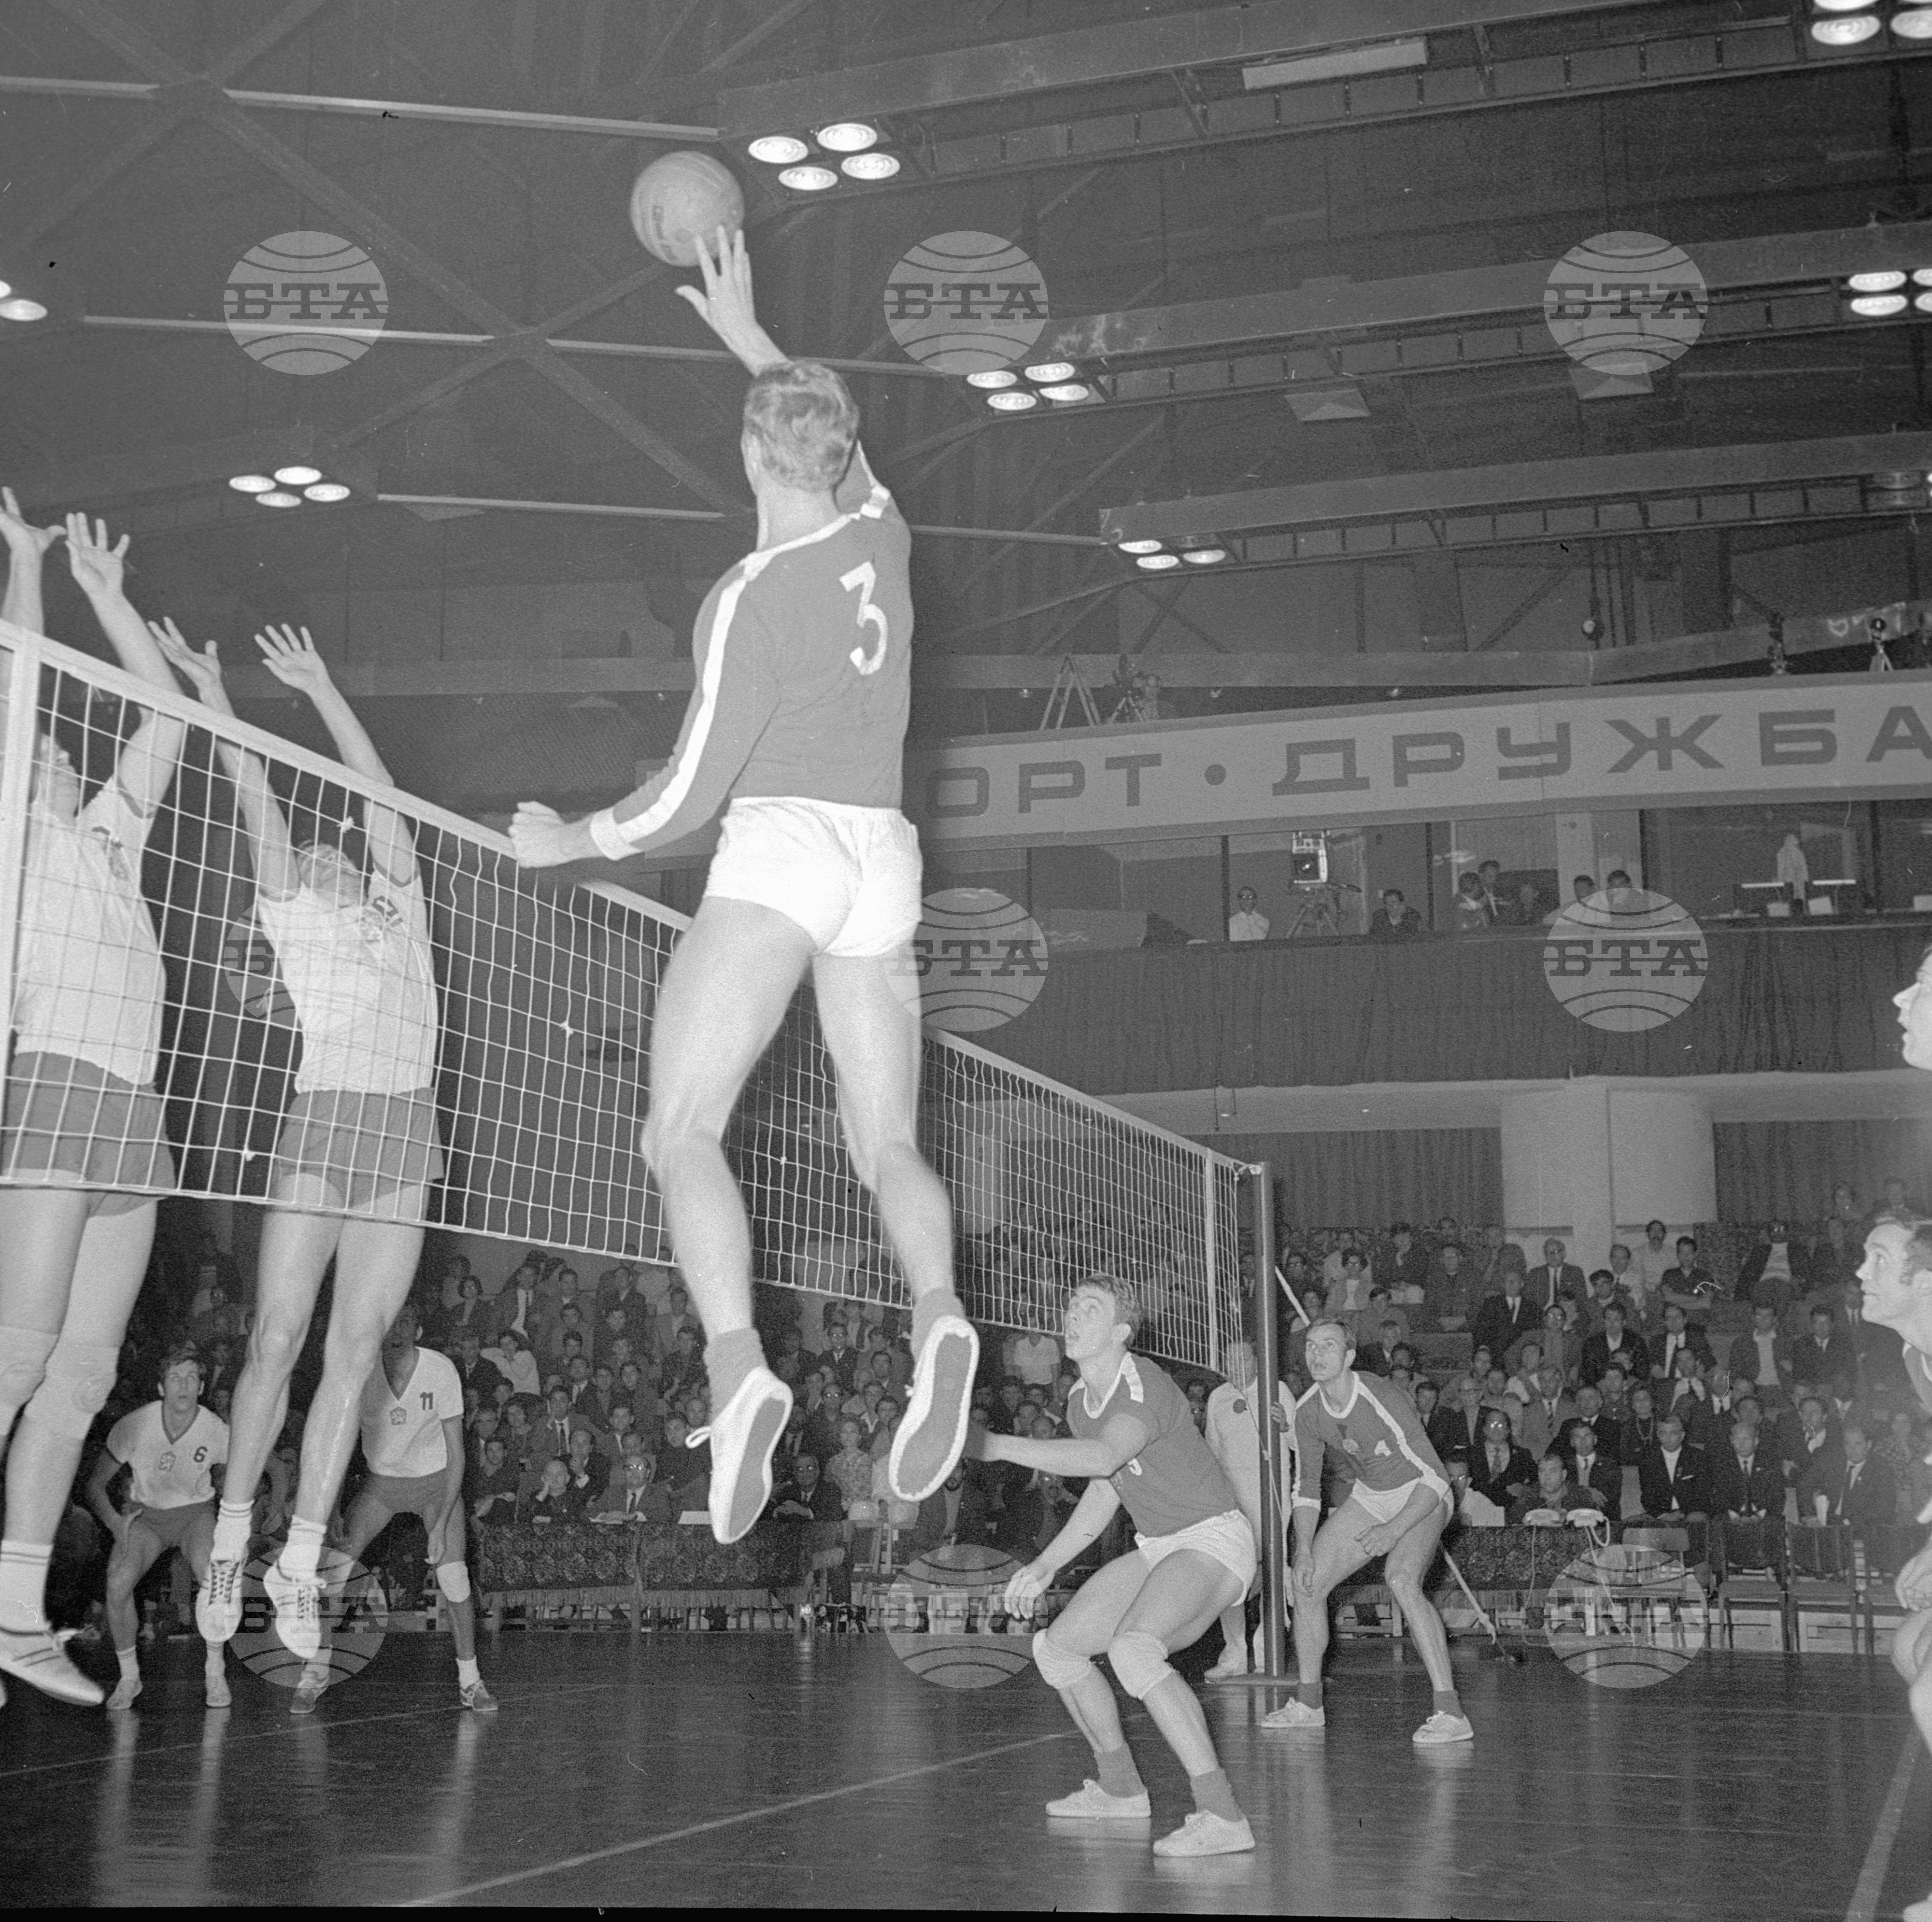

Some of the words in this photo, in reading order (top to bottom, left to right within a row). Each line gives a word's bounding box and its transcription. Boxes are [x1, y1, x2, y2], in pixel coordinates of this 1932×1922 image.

[839, 561, 888, 676] 3
[1272, 706, 1932, 796] ДРУЖБА
[420, 1392, 434, 1411] 11
[193, 1446, 208, 1463] 6
